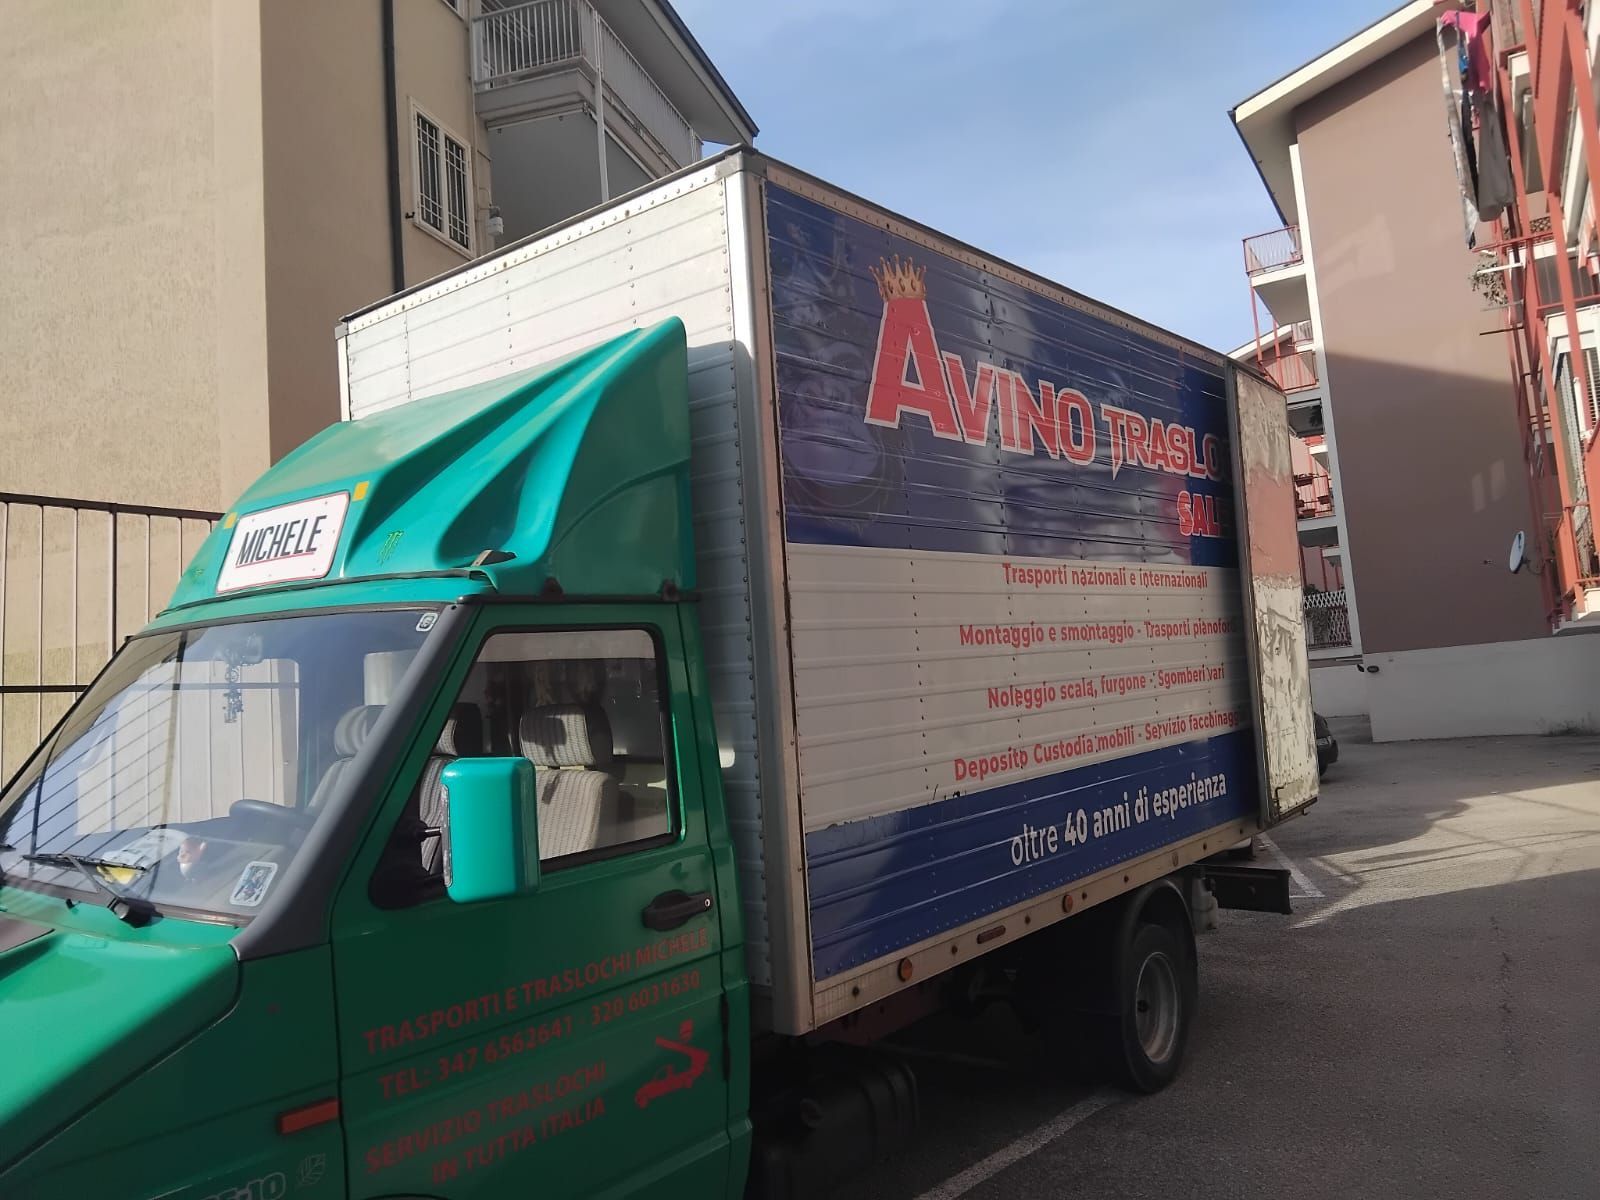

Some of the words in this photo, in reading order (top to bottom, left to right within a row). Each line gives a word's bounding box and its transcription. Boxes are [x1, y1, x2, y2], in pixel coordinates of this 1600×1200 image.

[863, 298, 1096, 466] AVINO
[1100, 404, 1226, 481] TRASLO
[235, 514, 327, 567] MICHELE
[1002, 563, 1067, 588] Trasporti
[1071, 565, 1127, 586] nazionali
[1130, 573, 1137, 585] e
[1140, 568, 1208, 589] internazionali
[959, 621, 1044, 648] Montaggio
[1048, 628, 1057, 641] e
[1061, 619, 1134, 643] smontaggio
[1144, 618, 1191, 640] Trasporti
[1193, 618, 1238, 639] pianofor
[988, 684, 1056, 709] Noleggio
[1060, 678, 1098, 699] scala,
[1100, 674, 1146, 696] furgone
[1158, 664, 1205, 689] Sgomberi
[1207, 662, 1225, 681] vari
[954, 748, 1028, 781] Deposito
[1033, 734, 1093, 764] Custodia
[1098, 726, 1135, 749] mobili
[1144, 715, 1186, 741] Servizio
[1189, 709, 1243, 731] facchinagg
[1011, 823, 1058, 866] oltre
[1064, 808, 1088, 846] 40
[1093, 792, 1130, 838] anni
[1134, 786, 1149, 822] di
[1152, 771, 1227, 820] esperienza
[362, 992, 500, 1056] TRASPORTI
[505, 986, 519, 1011] E
[520, 950, 631, 1005] TRASLOCHI
[635, 927, 707, 969] MICHELE
[378, 1067, 433, 1100] TEL:
[438, 1047, 479, 1082] 347
[484, 1017, 573, 1063] 6562641
[592, 997, 624, 1027] 320
[365, 1109, 482, 1175] SERVIZIO
[487, 1059, 607, 1125] TRASLOCHI
[431, 1159, 459, 1185] IN
[464, 1124, 537, 1171] TUTTA
[541, 1096, 606, 1141] ITALIA
